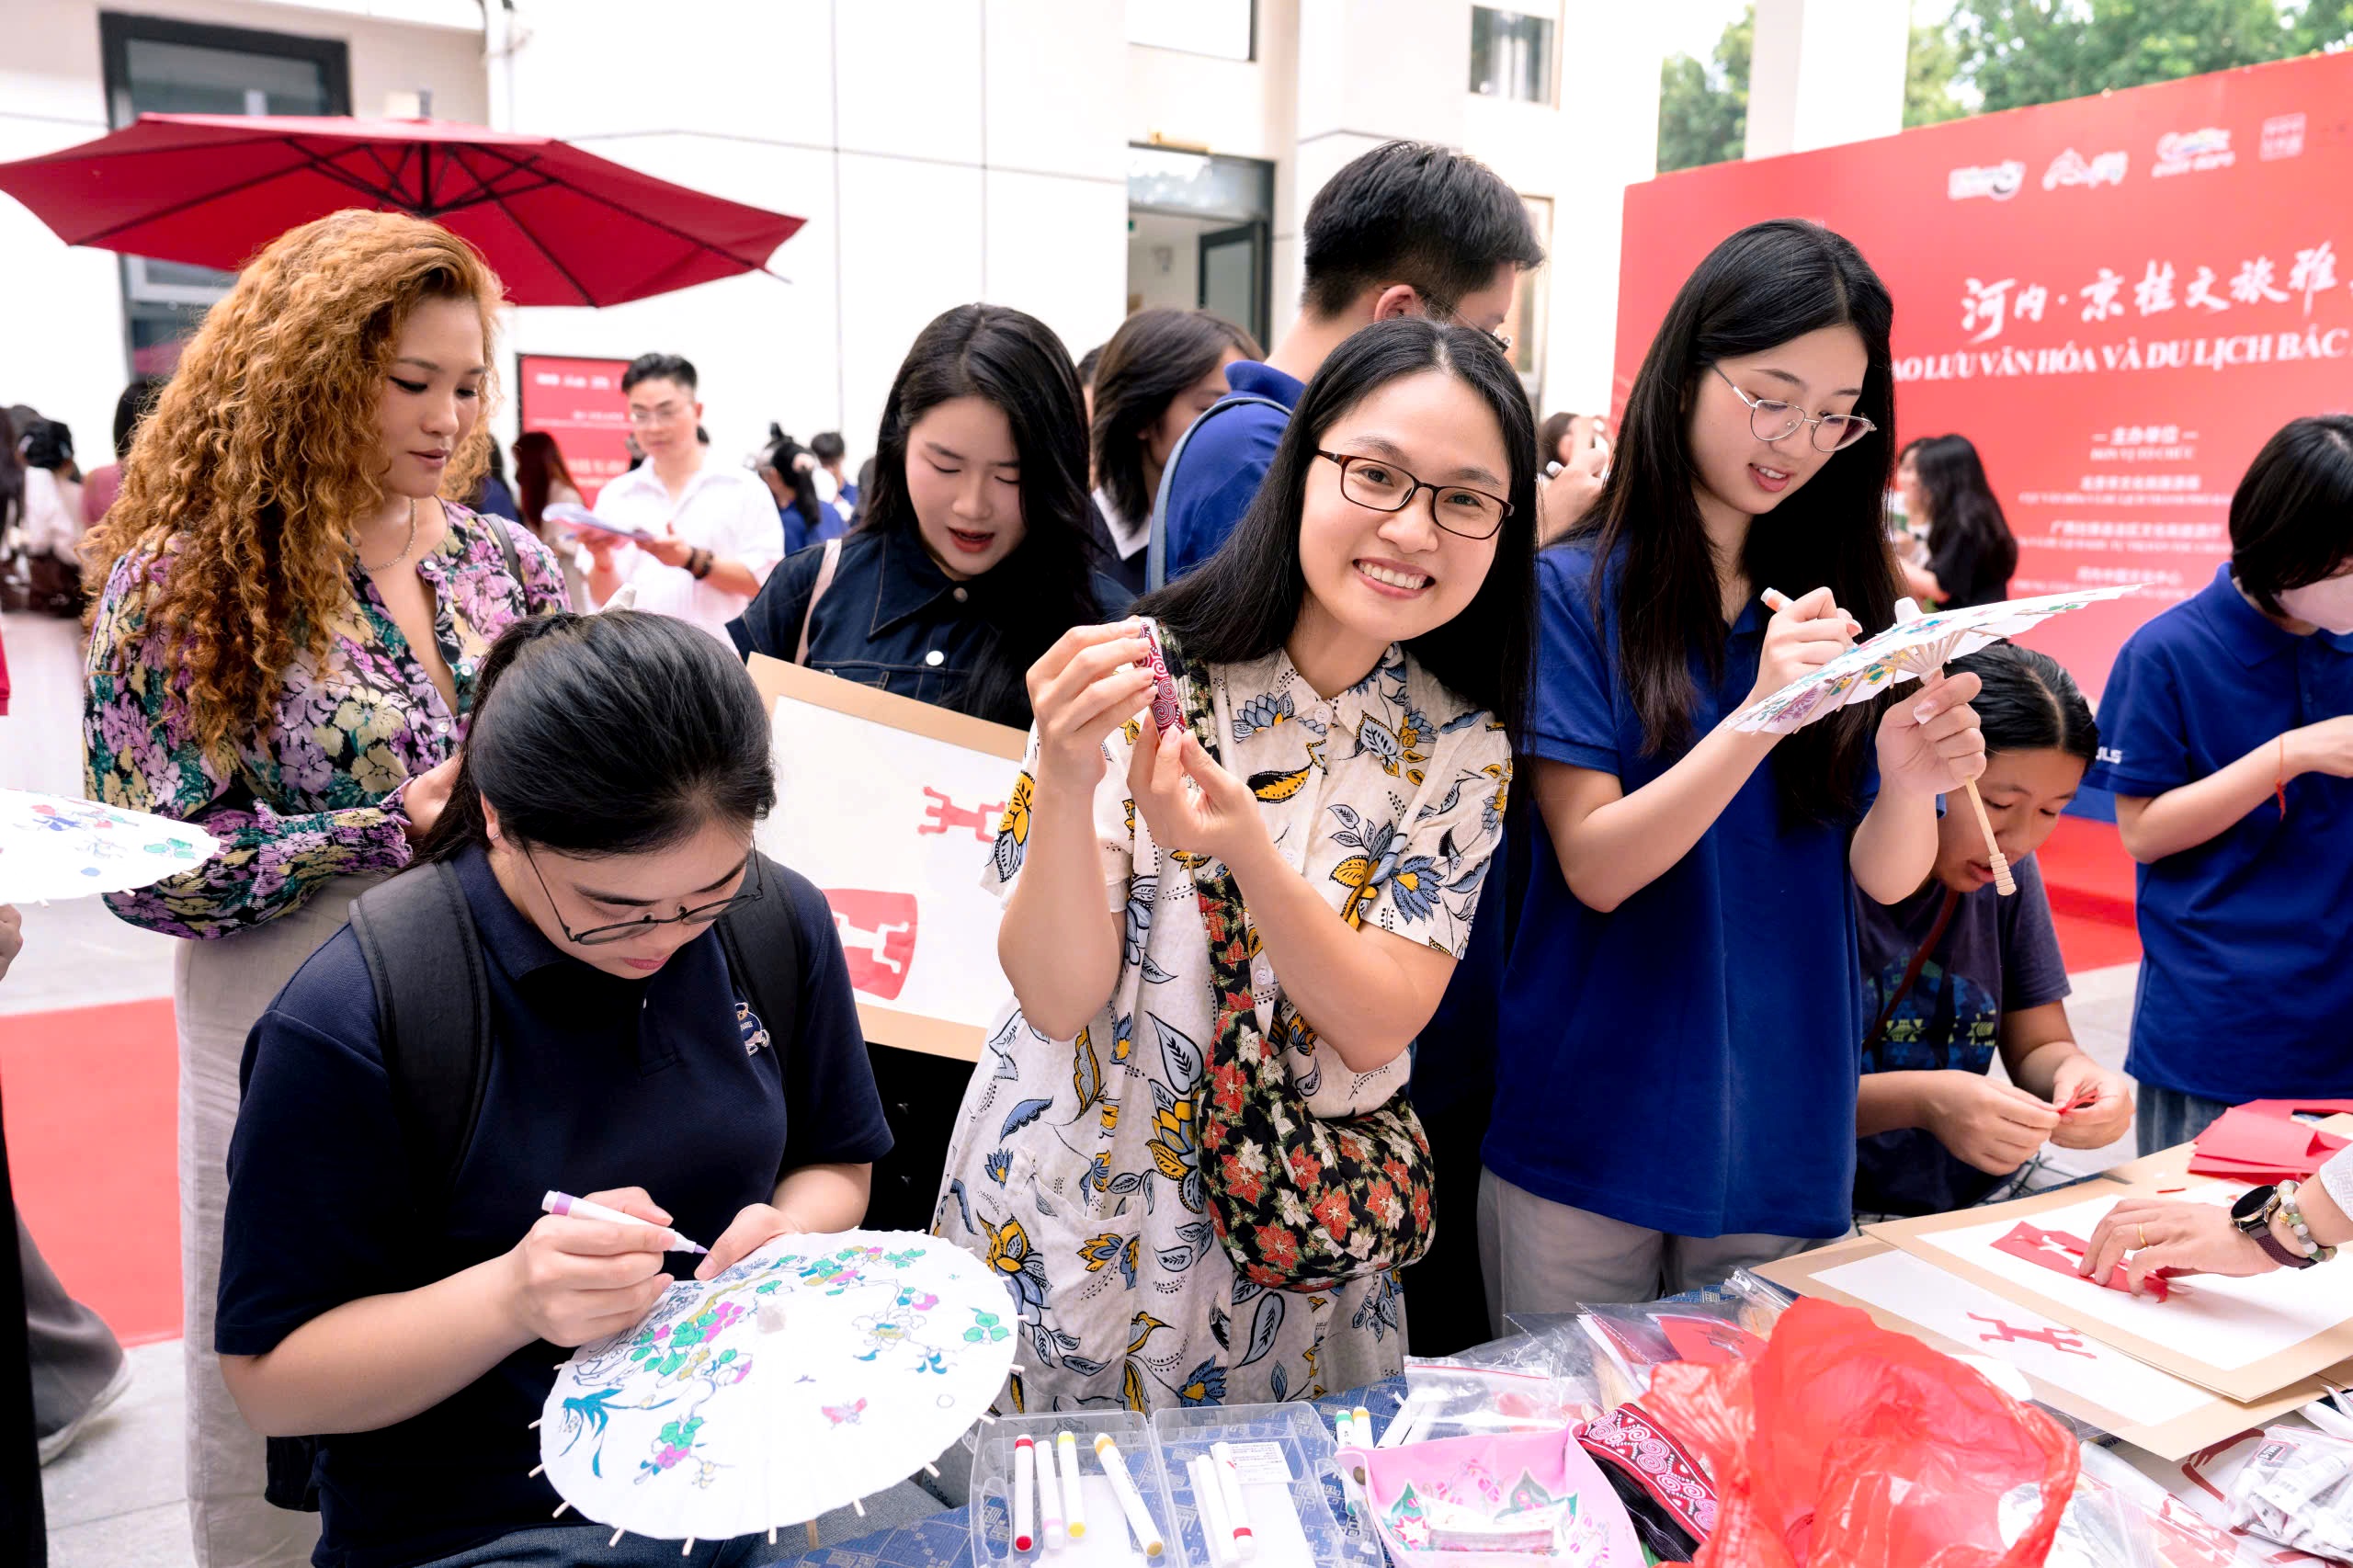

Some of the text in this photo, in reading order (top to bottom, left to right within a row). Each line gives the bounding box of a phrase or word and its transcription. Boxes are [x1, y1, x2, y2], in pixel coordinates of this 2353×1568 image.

[1961, 240, 2353, 345] 河内·京桂文旅雅
[2035, 340, 2097, 375] HÓA
[2146, 339, 2191, 369] DU
[2193, 335, 2272, 371] LỊCH
